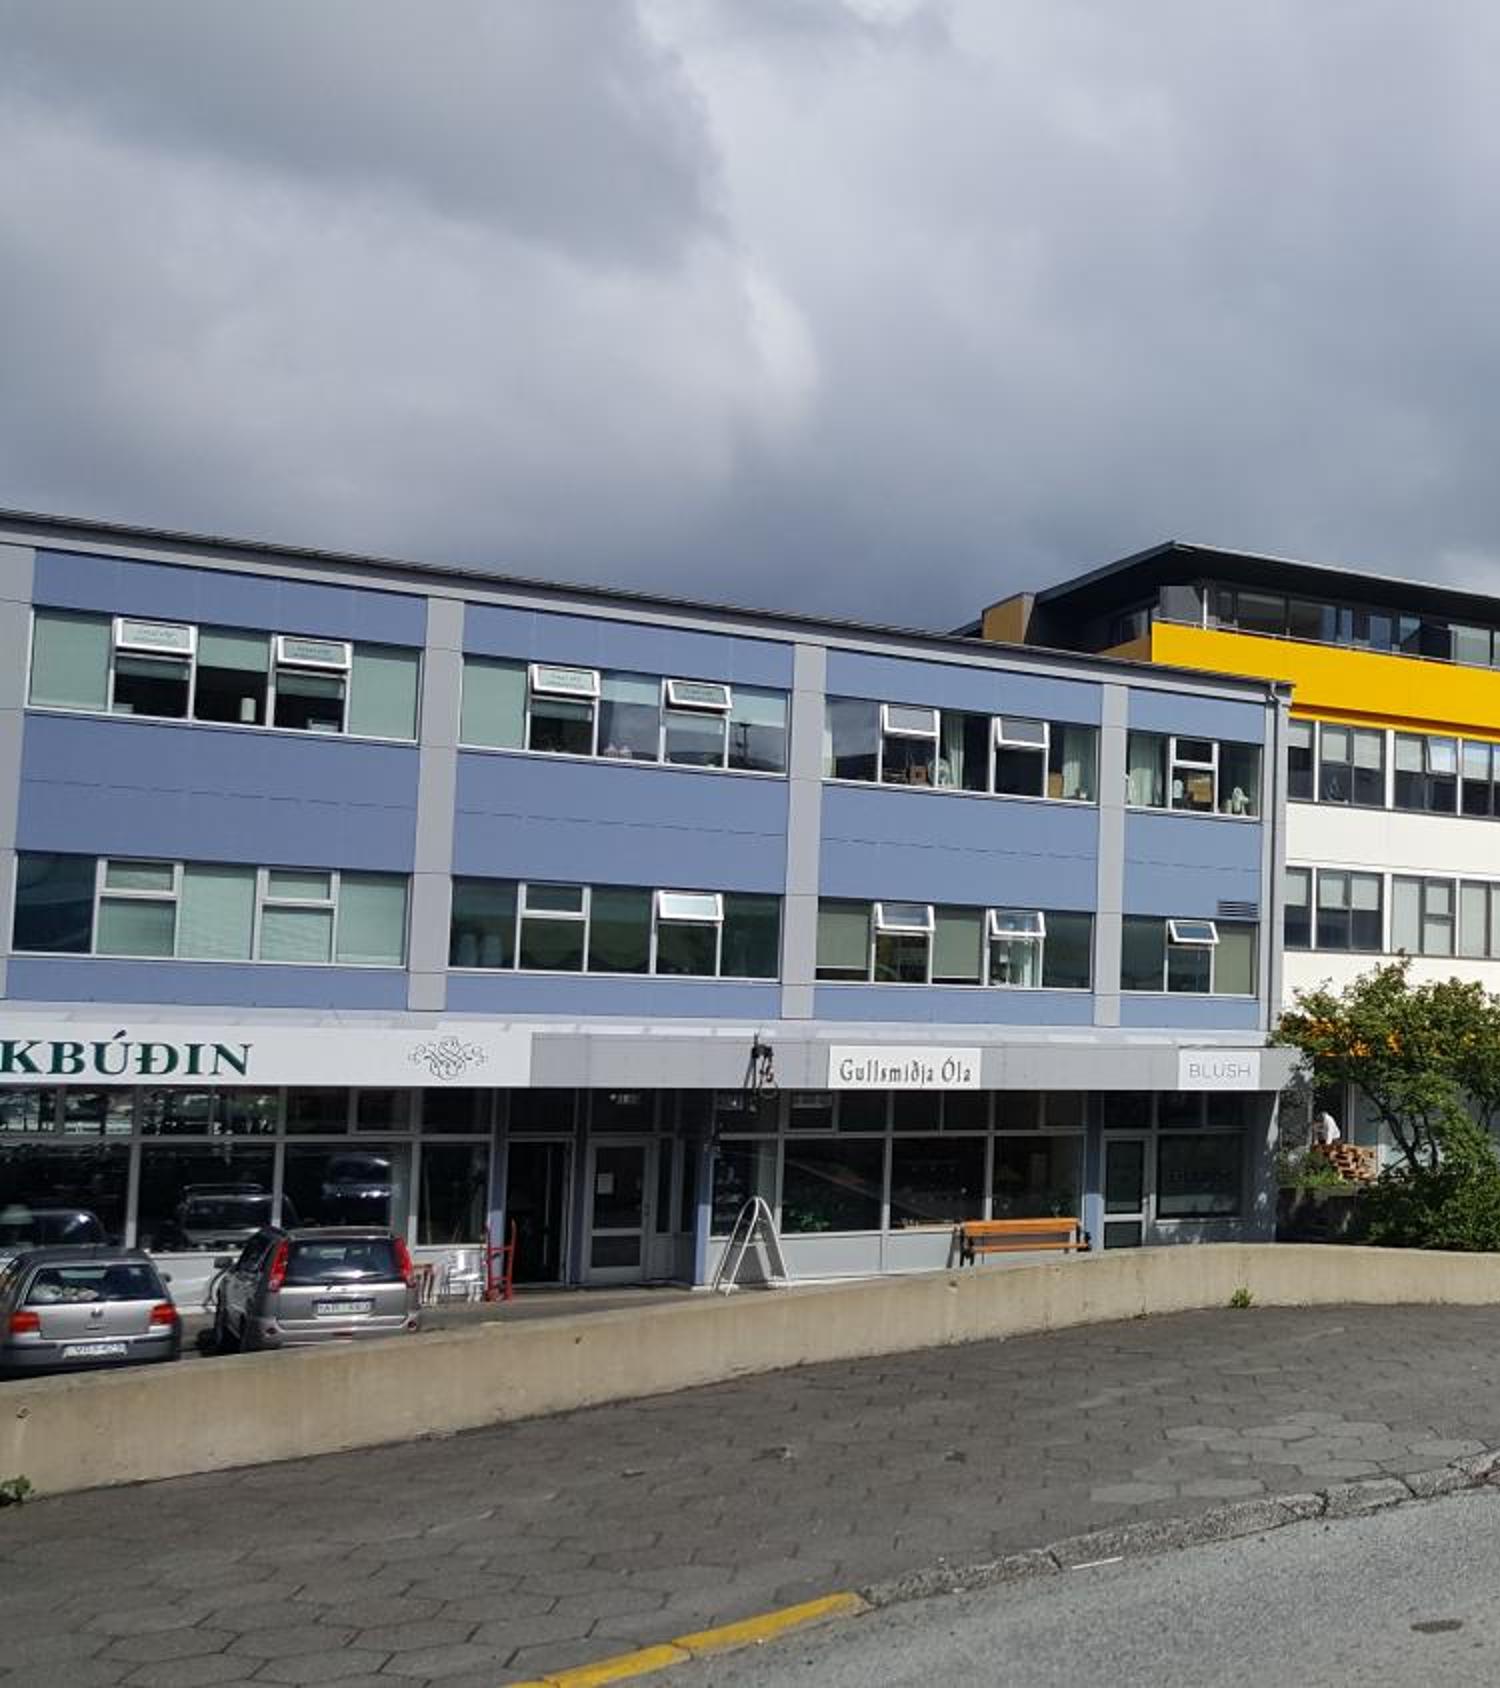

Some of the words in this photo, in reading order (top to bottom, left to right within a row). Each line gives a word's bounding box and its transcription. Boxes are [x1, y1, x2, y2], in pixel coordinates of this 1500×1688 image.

[0, 1029, 253, 1076] KBÚÐIN
[839, 1058, 933, 1085] Gullsmiðja
[941, 1056, 971, 1083] Óla
[1189, 1063, 1250, 1079] BLUSH
